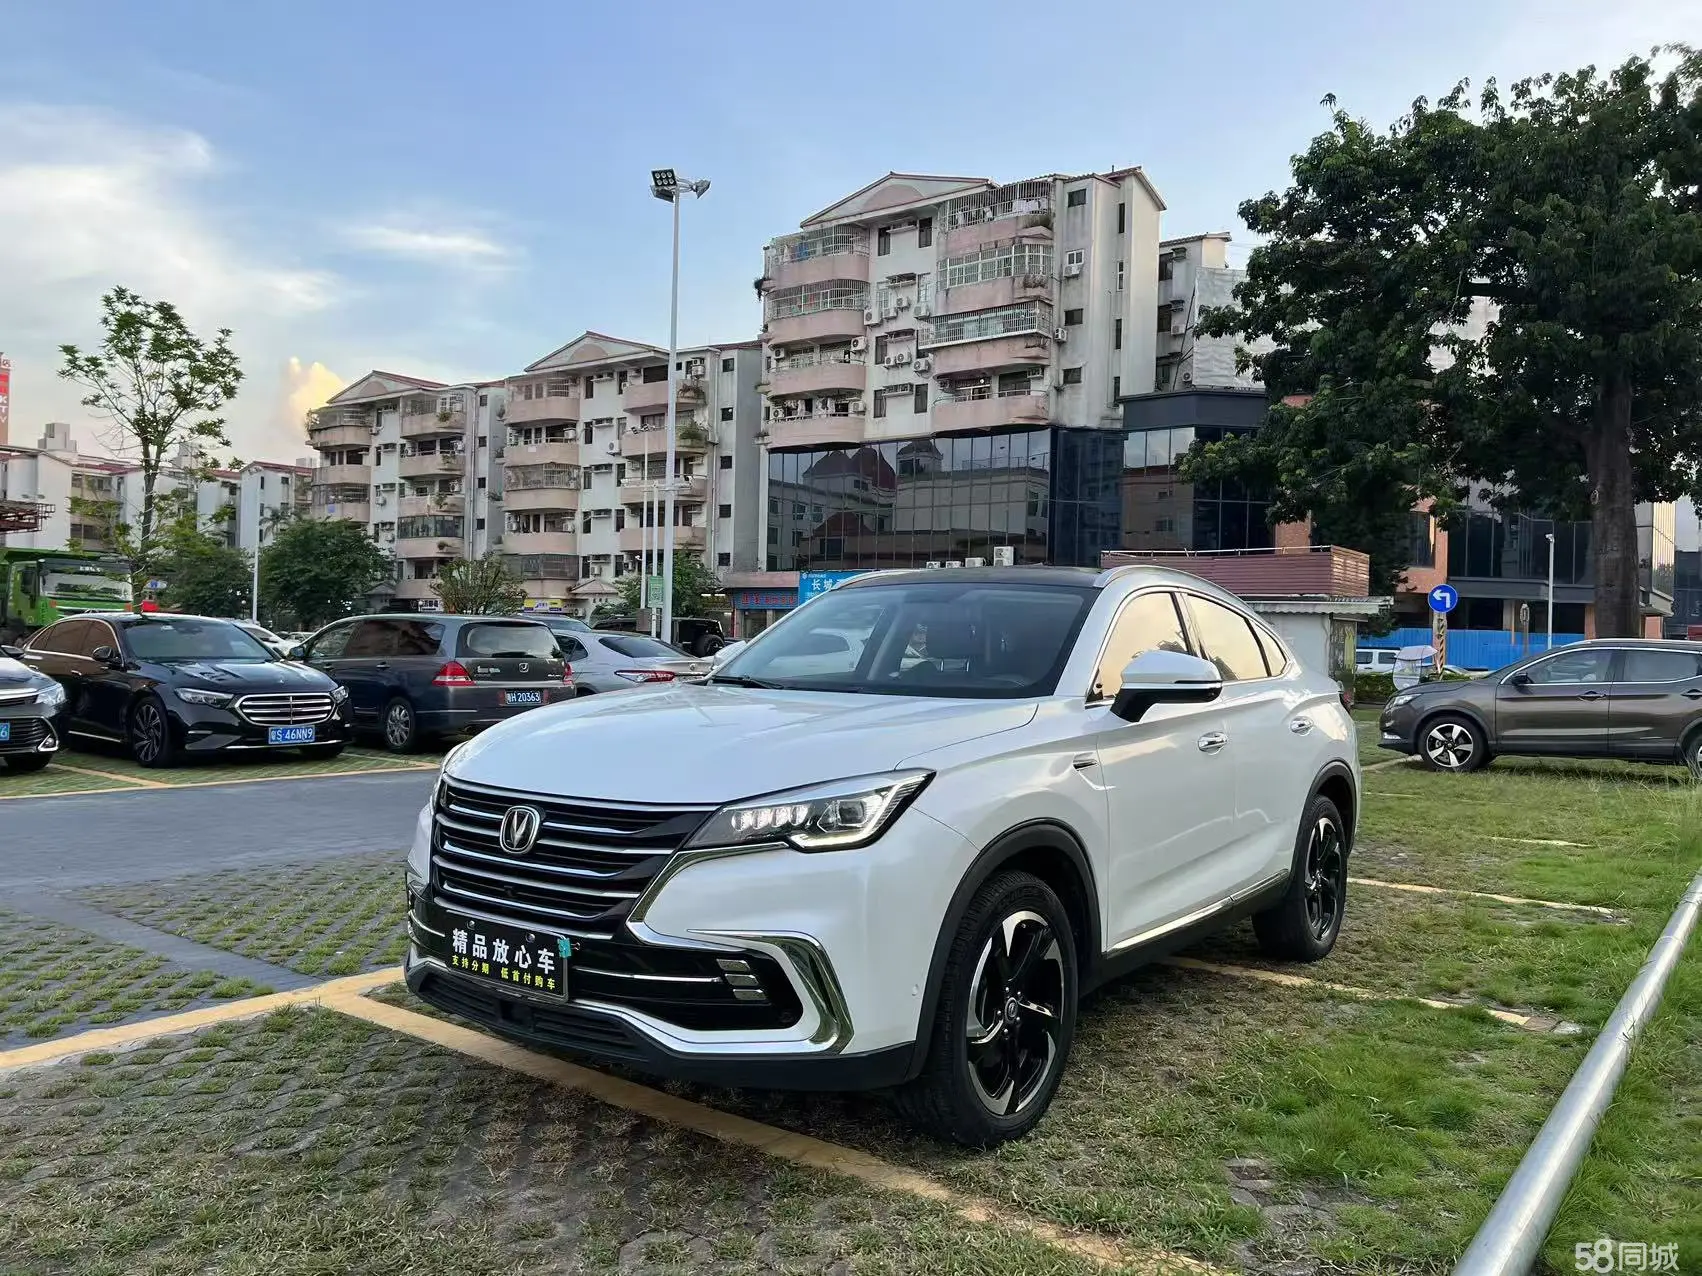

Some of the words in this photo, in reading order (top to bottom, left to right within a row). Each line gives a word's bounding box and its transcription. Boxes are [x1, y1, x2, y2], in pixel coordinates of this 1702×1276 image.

[812, 578, 841, 591] 长城
[452, 928, 555, 975] 精品放心车
[452, 954, 490, 975] 支持分期
[500, 966, 556, 990] 低首付购车
